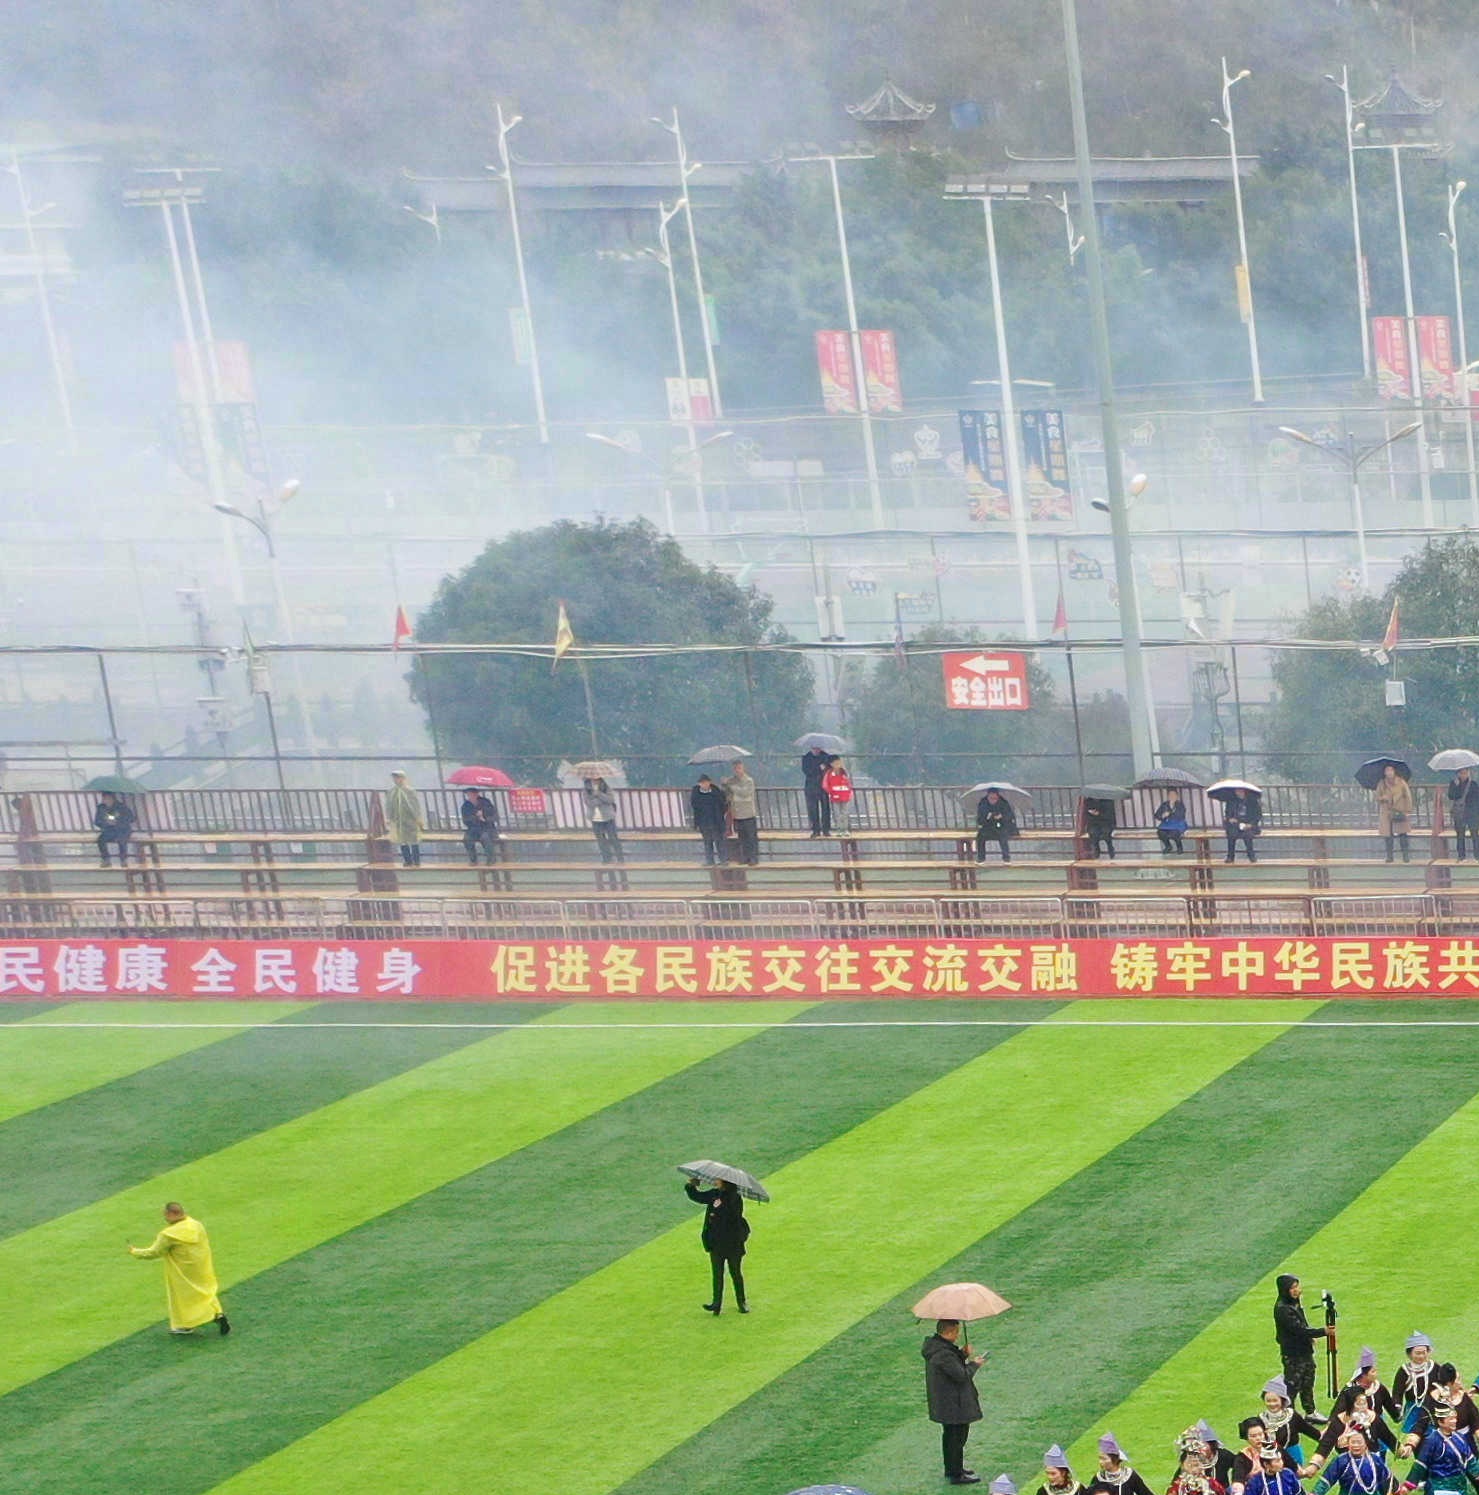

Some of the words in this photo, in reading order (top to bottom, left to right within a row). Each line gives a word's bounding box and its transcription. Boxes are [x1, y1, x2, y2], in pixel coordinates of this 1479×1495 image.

[951, 675, 1022, 707] 安全出口
[190, 947, 422, 994] 全民健身
[491, 944, 1079, 993] 促进各民族交往交流交融
